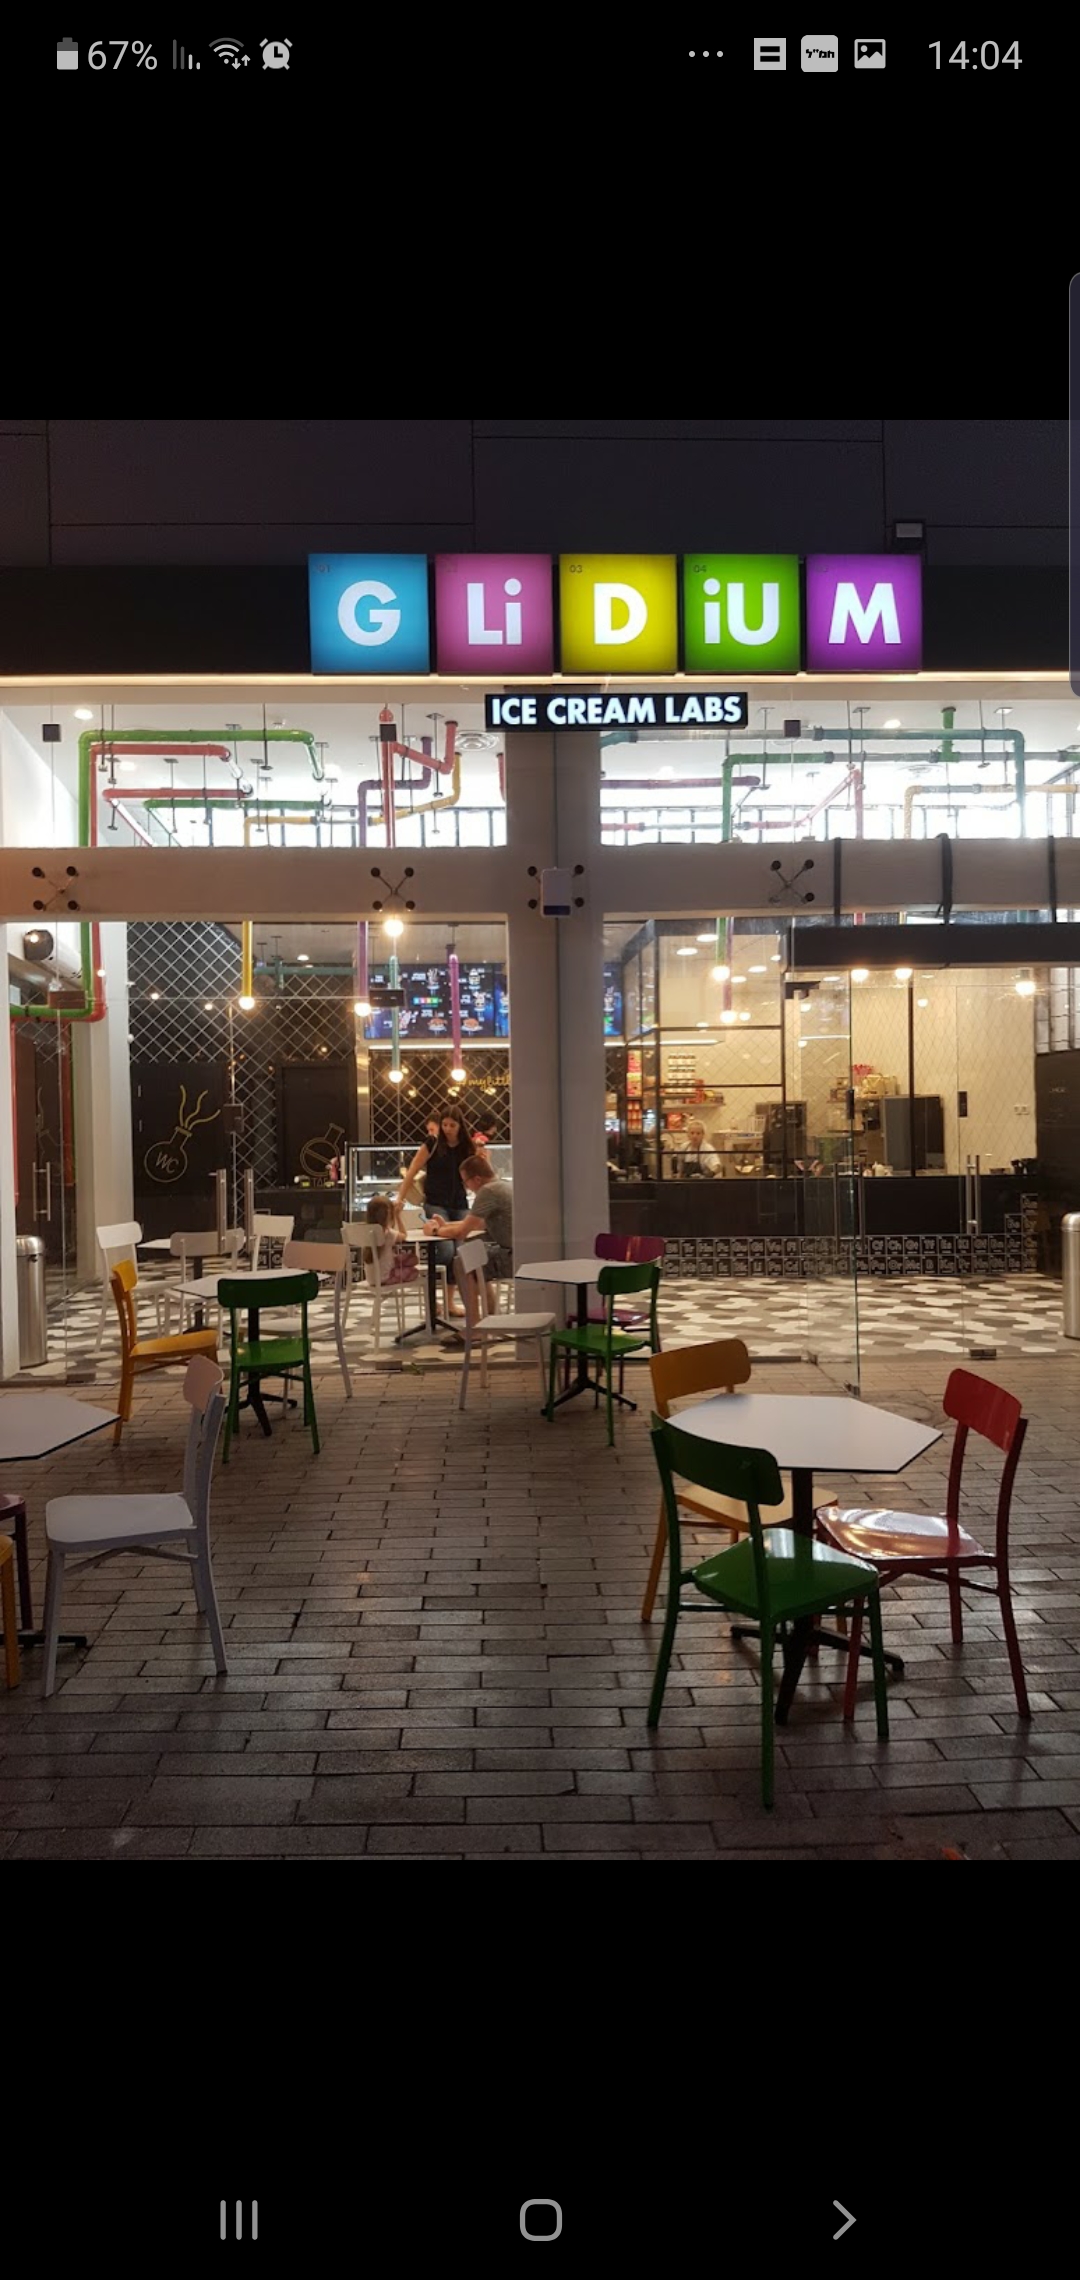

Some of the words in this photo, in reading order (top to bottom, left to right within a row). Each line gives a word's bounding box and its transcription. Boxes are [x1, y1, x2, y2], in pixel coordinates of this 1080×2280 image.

[492, 698, 537, 725] ICE
[547, 697, 656, 725] CREAM
[665, 696, 741, 723] LABS
[155, 1150, 180, 1175] WC
